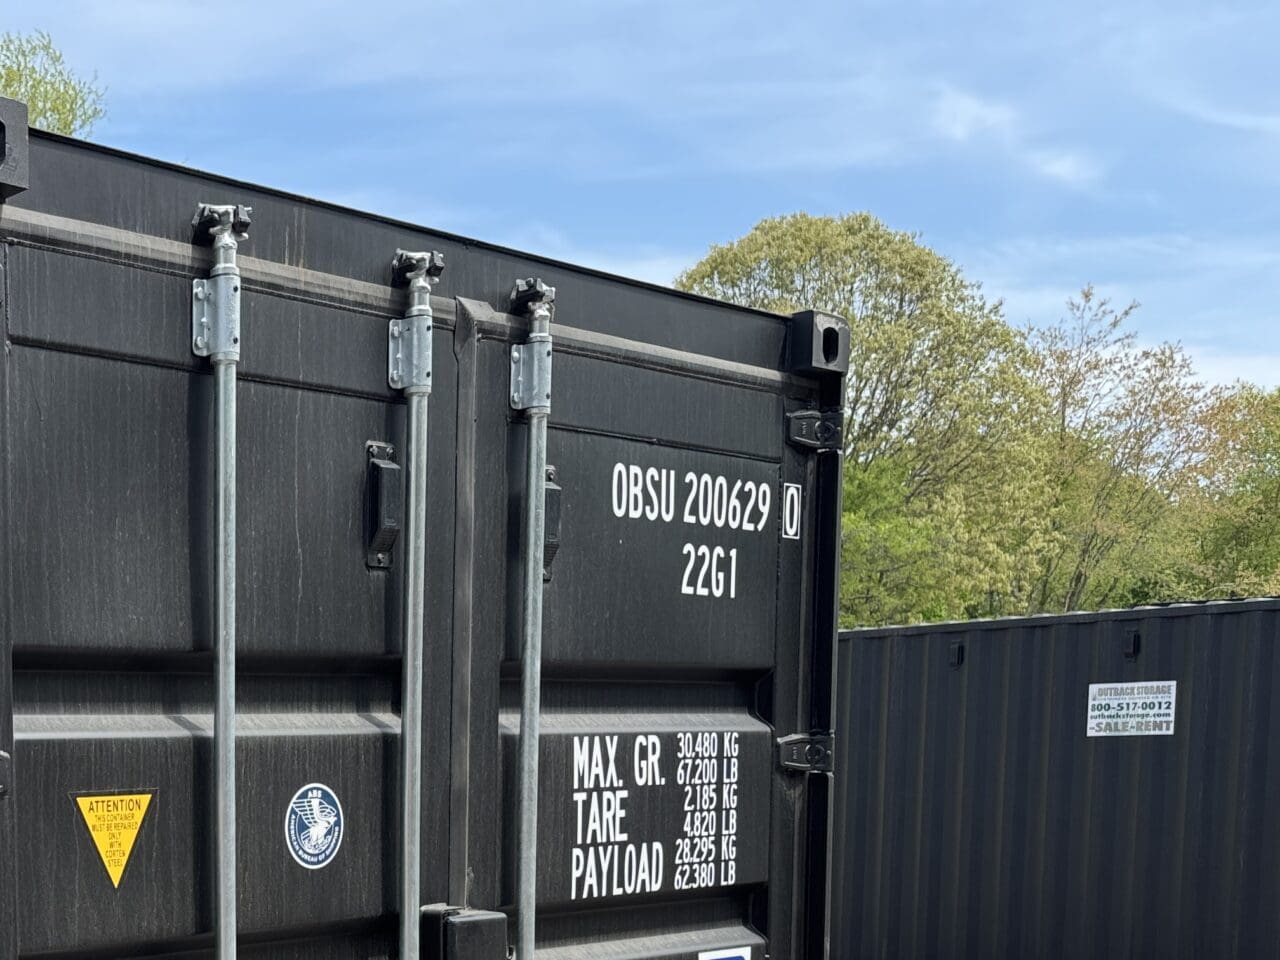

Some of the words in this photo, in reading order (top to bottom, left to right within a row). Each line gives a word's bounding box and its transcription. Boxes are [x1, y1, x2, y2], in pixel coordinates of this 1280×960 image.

[612, 462, 676, 523] OBSU
[683, 471, 771, 532] 200629
[784, 485, 799, 537] 0
[681, 542, 738, 599] 22G1
[1090, 701, 1172, 712] 800-517-0012
[1095, 721, 1129, 733] SALE
[1136, 720, 1173, 732] RENT
[573, 735, 623, 789] MAX.
[634, 735, 665, 786] GR.
[723, 732, 739, 757] KG
[722, 758, 738, 783] LB
[88, 799, 141, 813] ATTENTION
[573, 790, 629, 845] TARE
[722, 784, 737, 809] KG
[722, 810, 737, 835] LB
[571, 842, 664, 900] PAYLOAD
[721, 835, 737, 860] KG
[720, 861, 736, 886] LB
